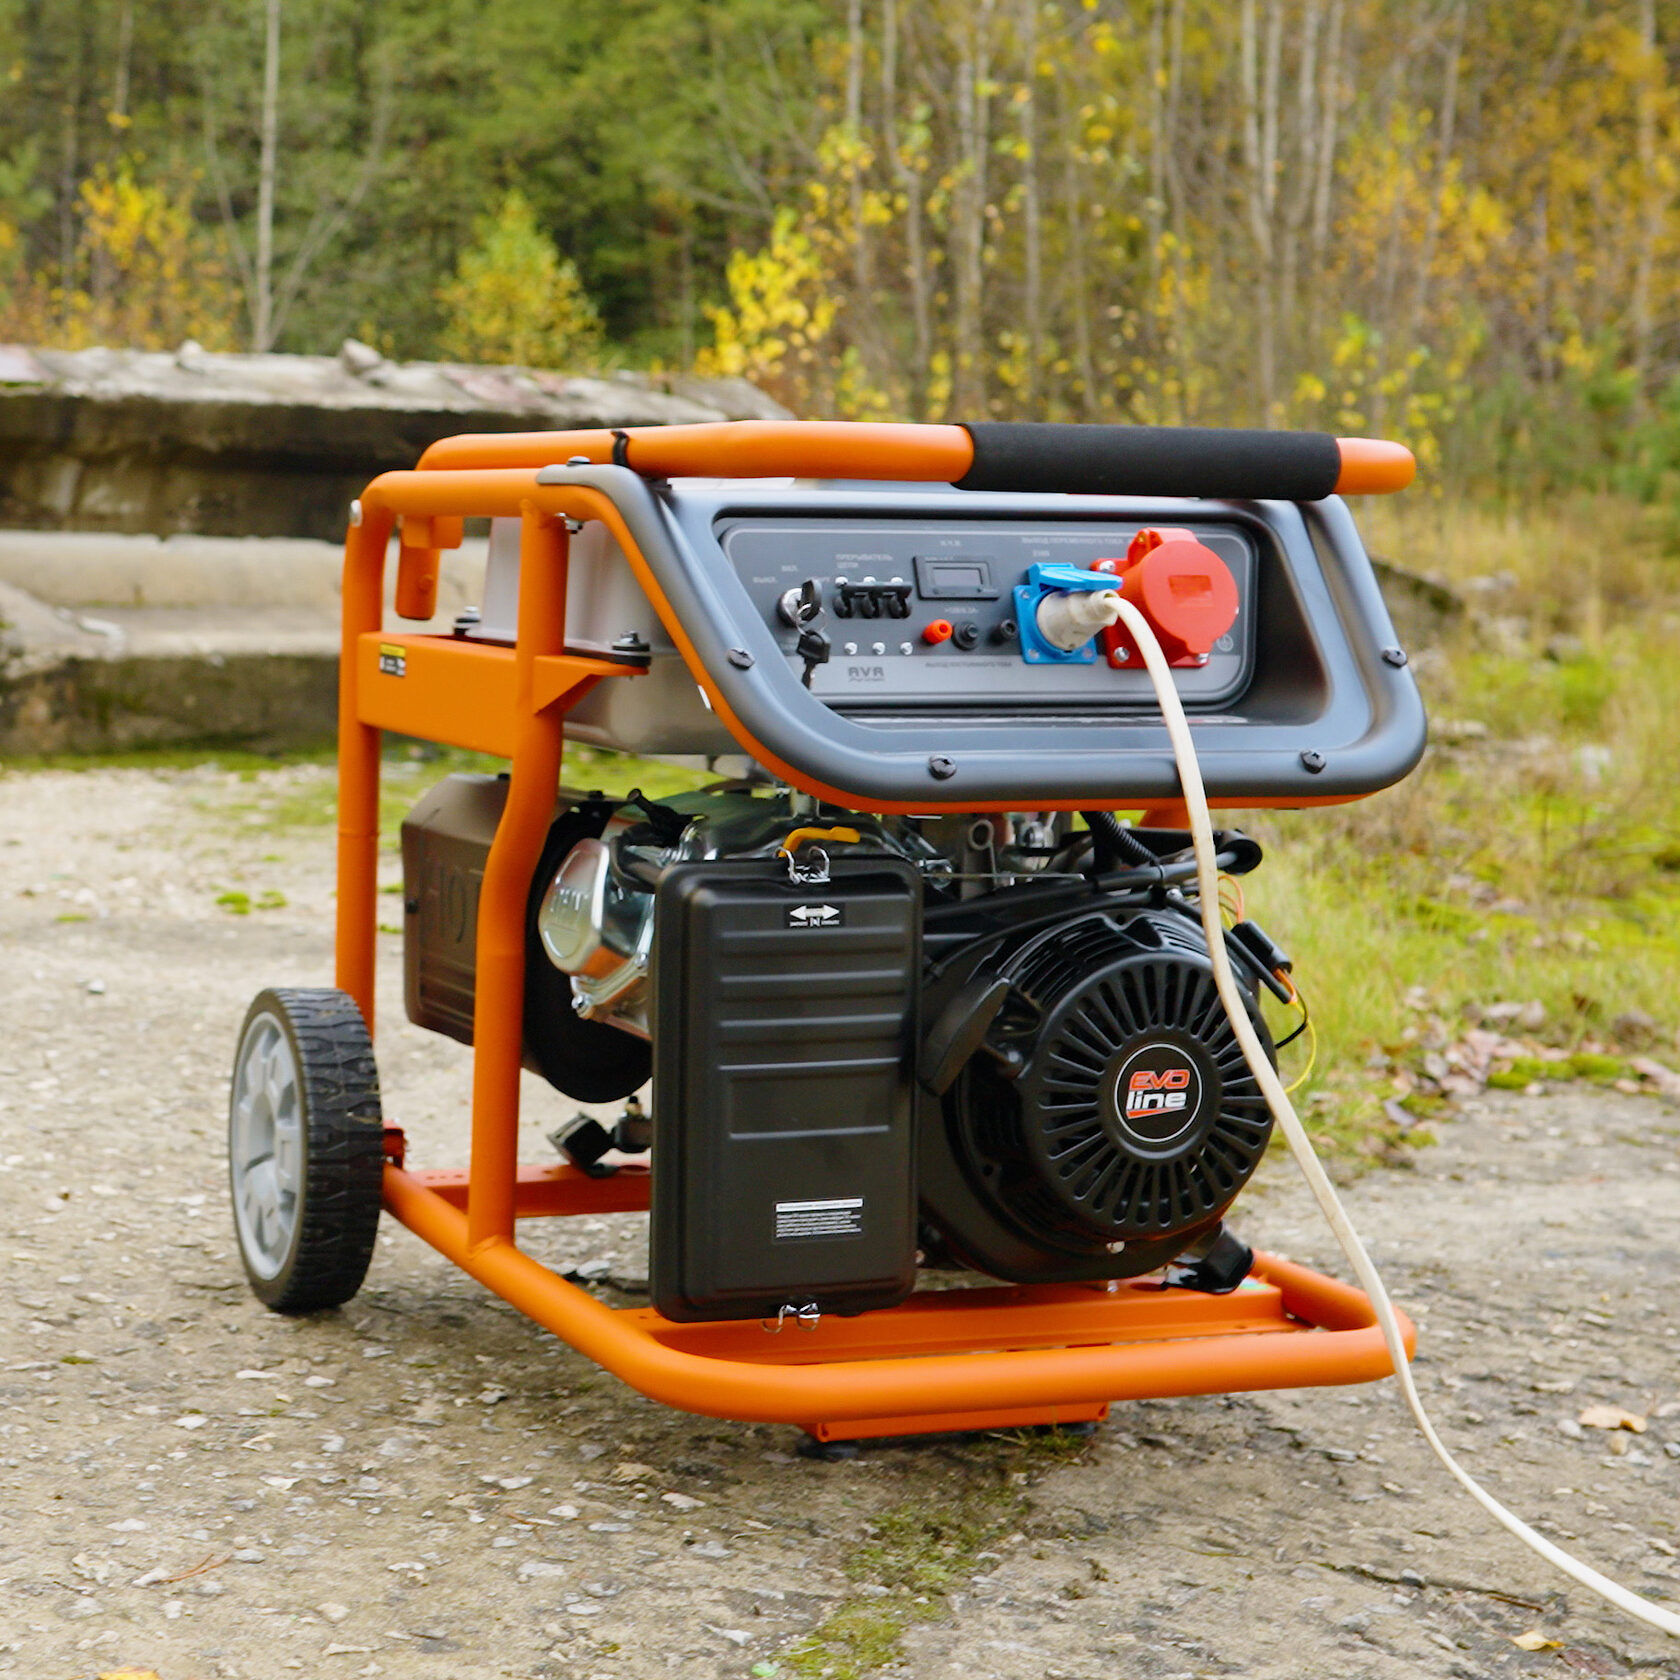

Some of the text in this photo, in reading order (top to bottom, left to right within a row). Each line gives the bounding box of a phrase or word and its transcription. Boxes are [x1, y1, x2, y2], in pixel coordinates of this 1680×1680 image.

[848, 667, 884, 677] AVR
[1129, 1069, 1190, 1090] EVO
[1126, 1090, 1187, 1110] line
